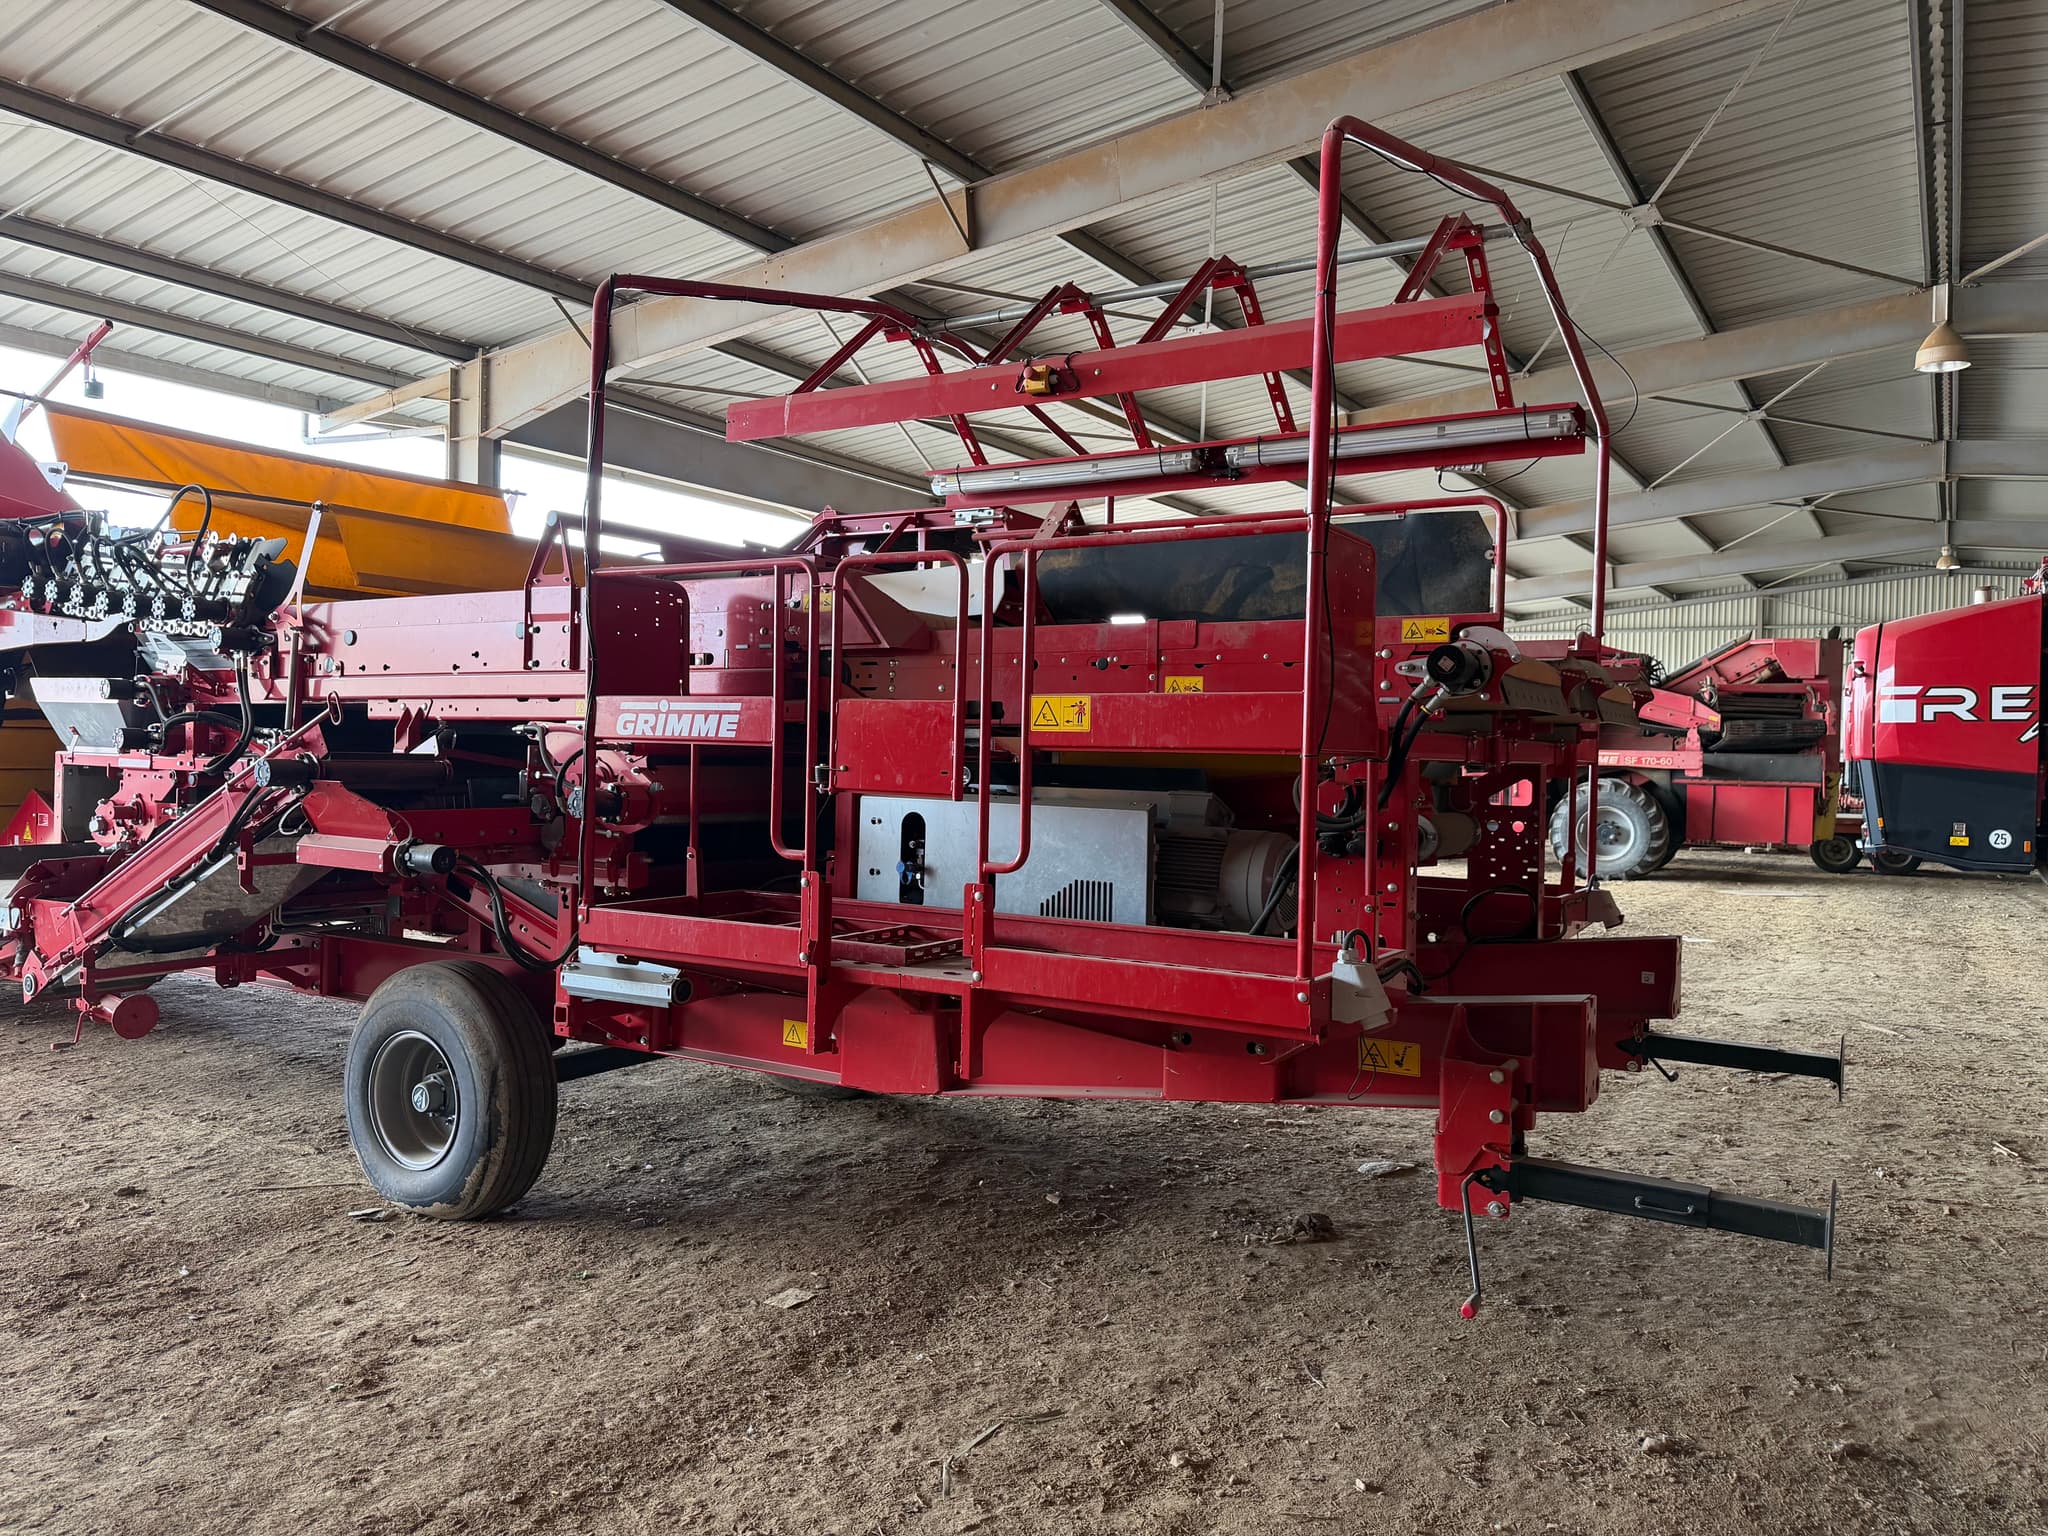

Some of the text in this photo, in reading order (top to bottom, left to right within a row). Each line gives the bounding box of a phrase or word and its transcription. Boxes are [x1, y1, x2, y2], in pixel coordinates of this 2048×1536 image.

[1921, 685, 2040, 743] RE
[616, 713, 740, 738] GRIMME
[1624, 756, 1638, 765] SF
[1641, 757, 1673, 766] 170-60
[1994, 833, 2007, 845] 25
